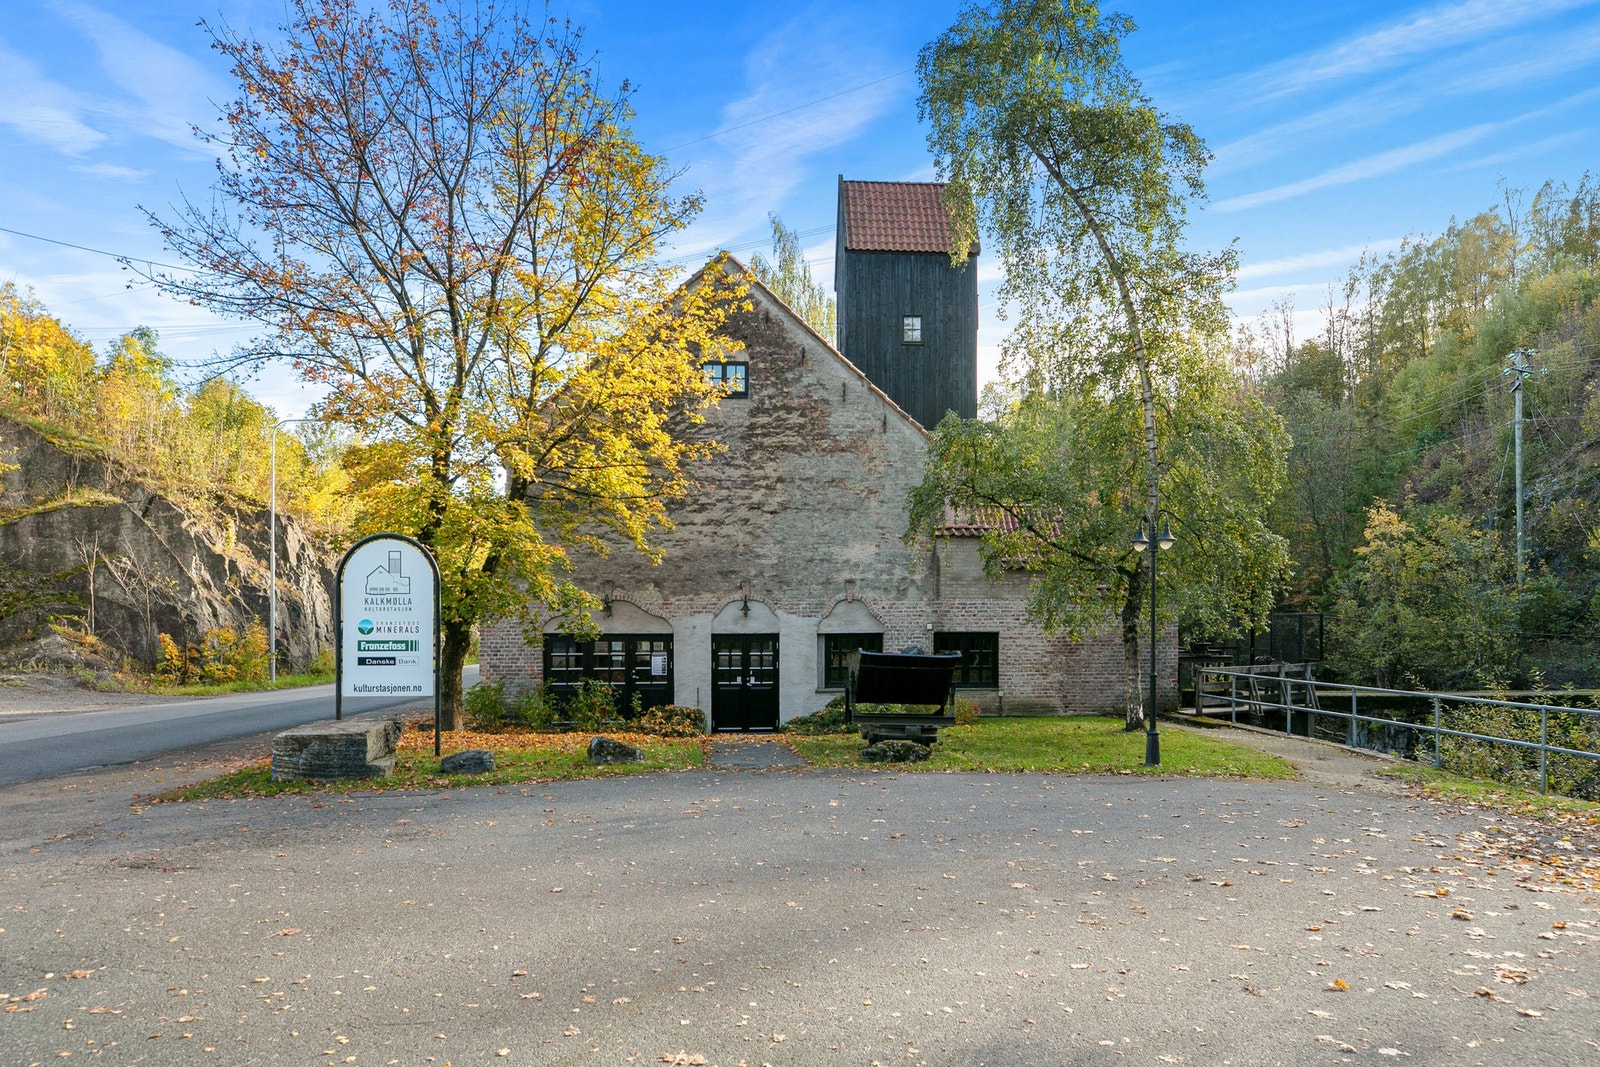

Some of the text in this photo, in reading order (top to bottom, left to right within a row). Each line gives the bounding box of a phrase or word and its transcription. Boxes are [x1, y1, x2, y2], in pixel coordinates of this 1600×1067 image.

[364, 597, 413, 606] KALKMØLLA
[360, 641, 406, 651] Franzefoss
[353, 684, 422, 694] kulturstasjonen.no
